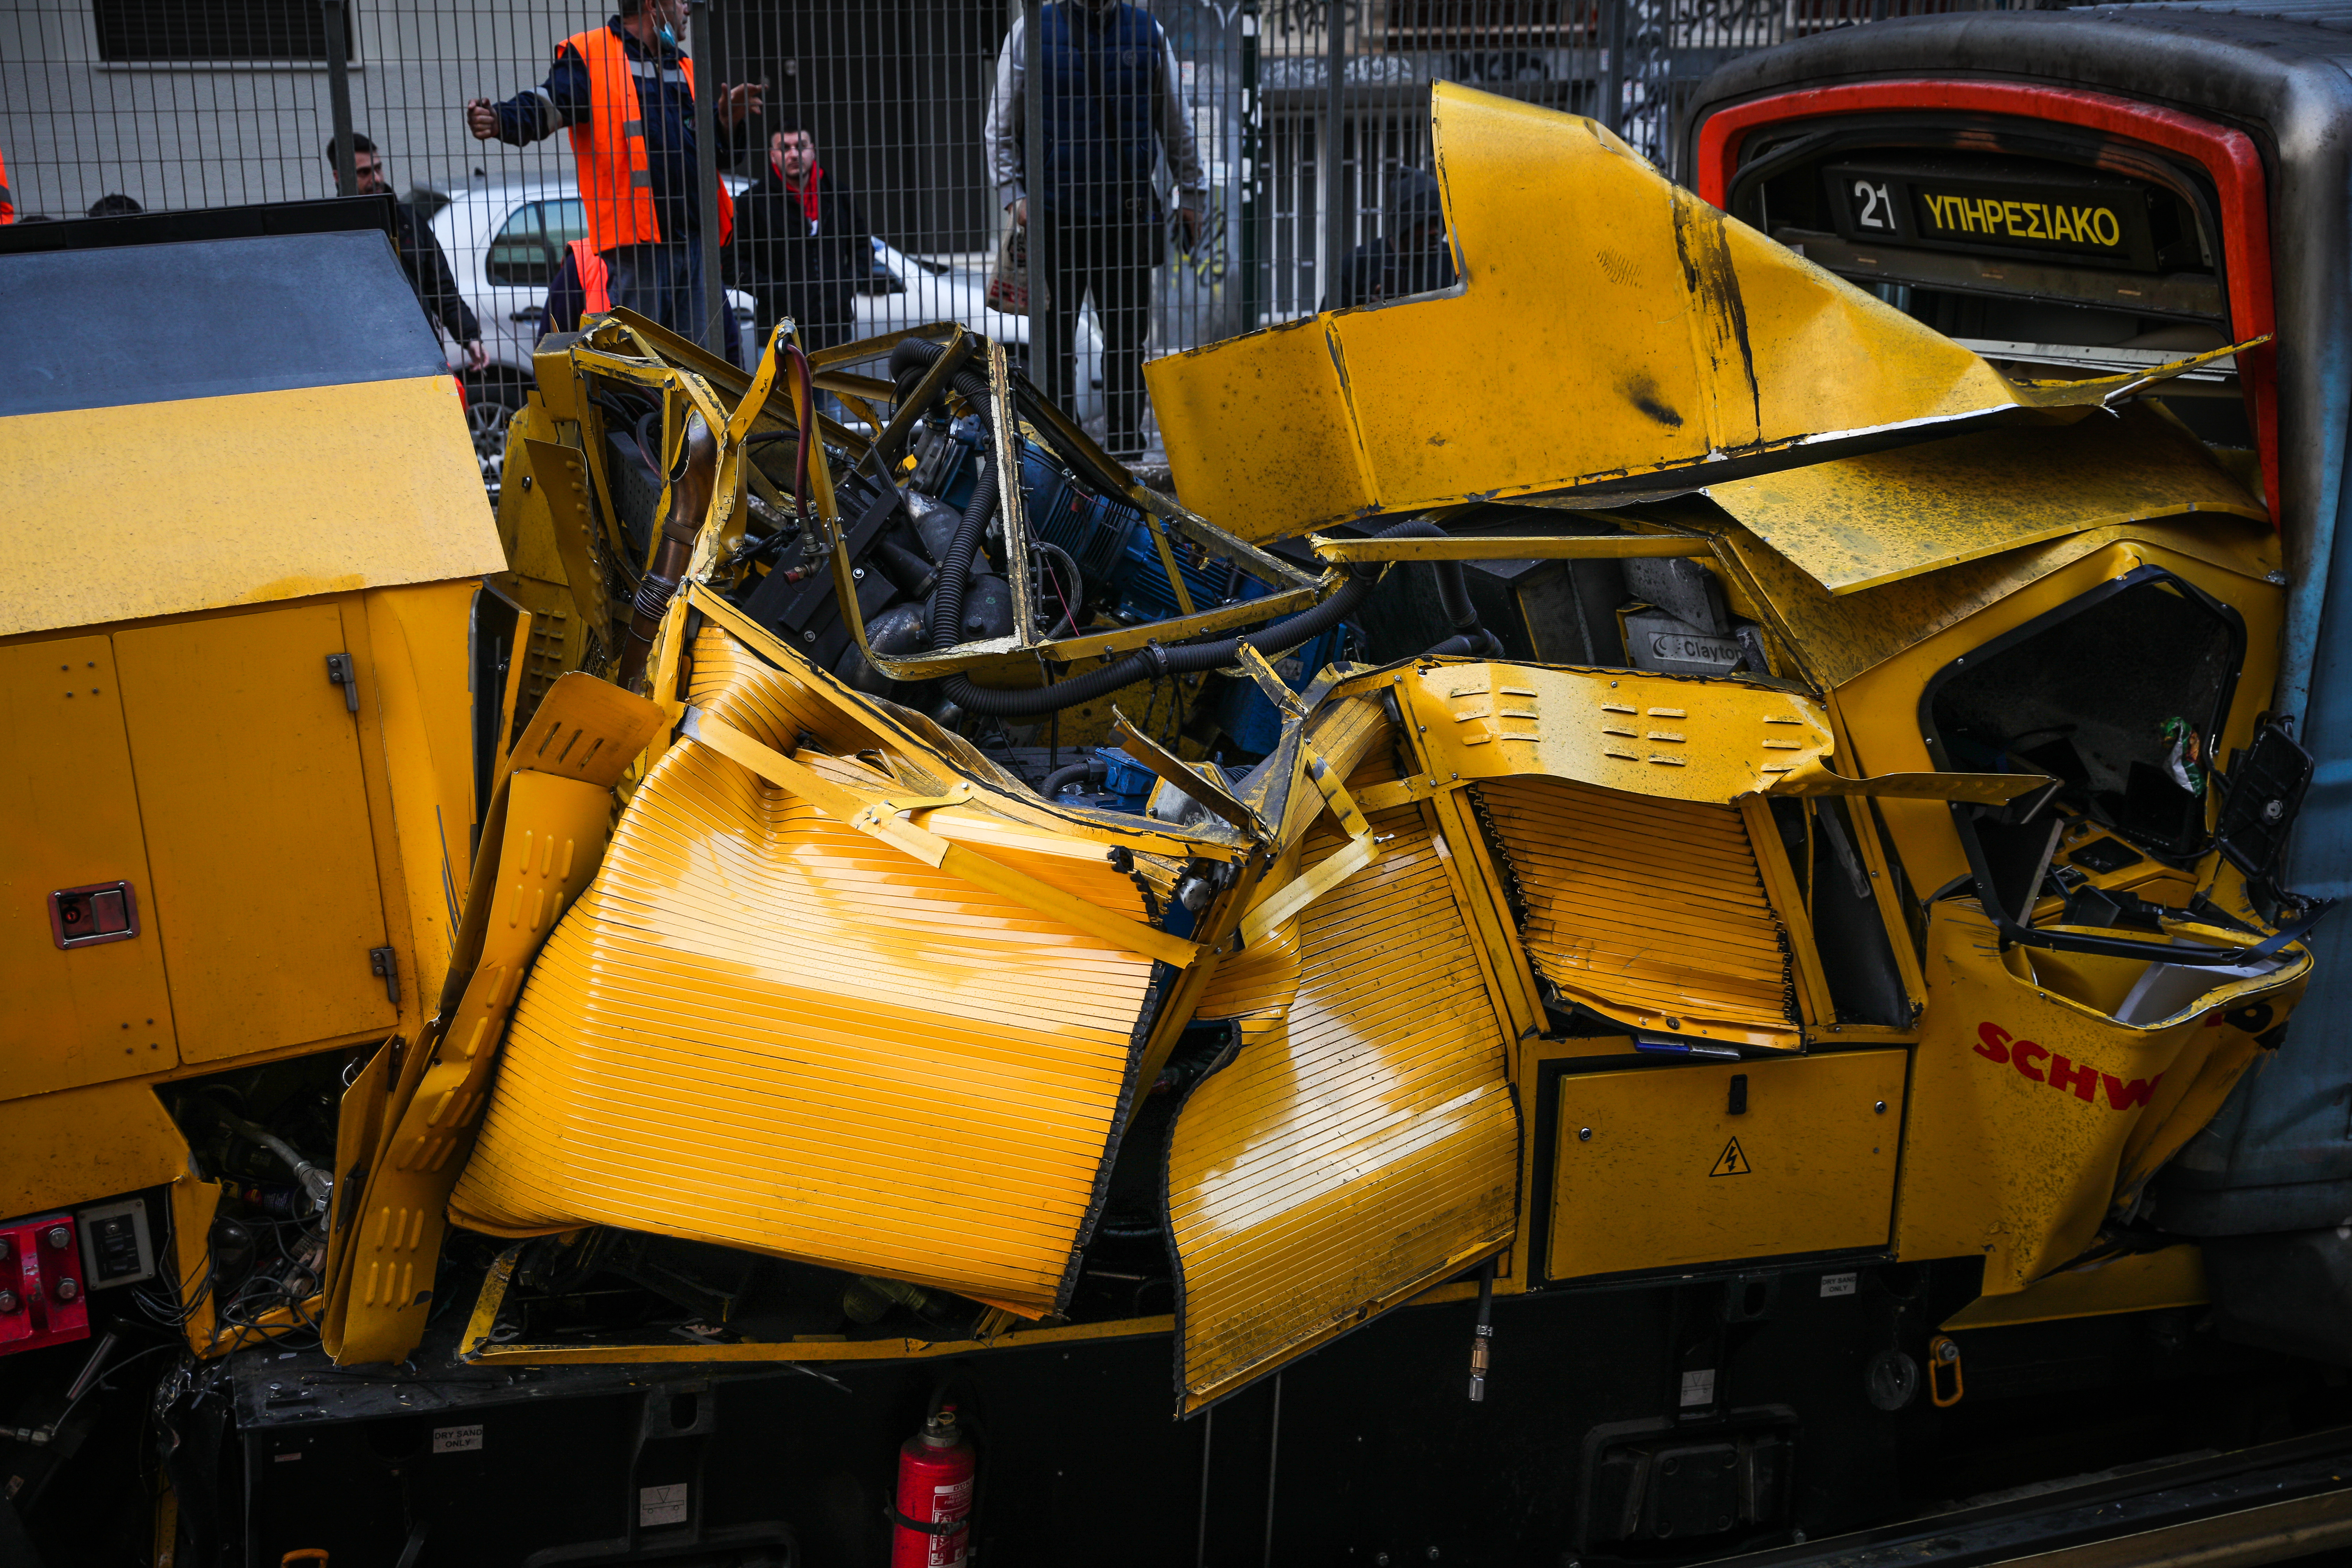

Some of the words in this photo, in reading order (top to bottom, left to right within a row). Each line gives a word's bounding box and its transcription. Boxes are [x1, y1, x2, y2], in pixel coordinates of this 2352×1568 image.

[1855, 180, 1896, 229] 21
[1924, 193, 2120, 246] ΥΠΗΡΕΣΙΑΚΟ
[445, 1439, 471, 1447] ONLY
[457, 1429, 482, 1437] SAND
